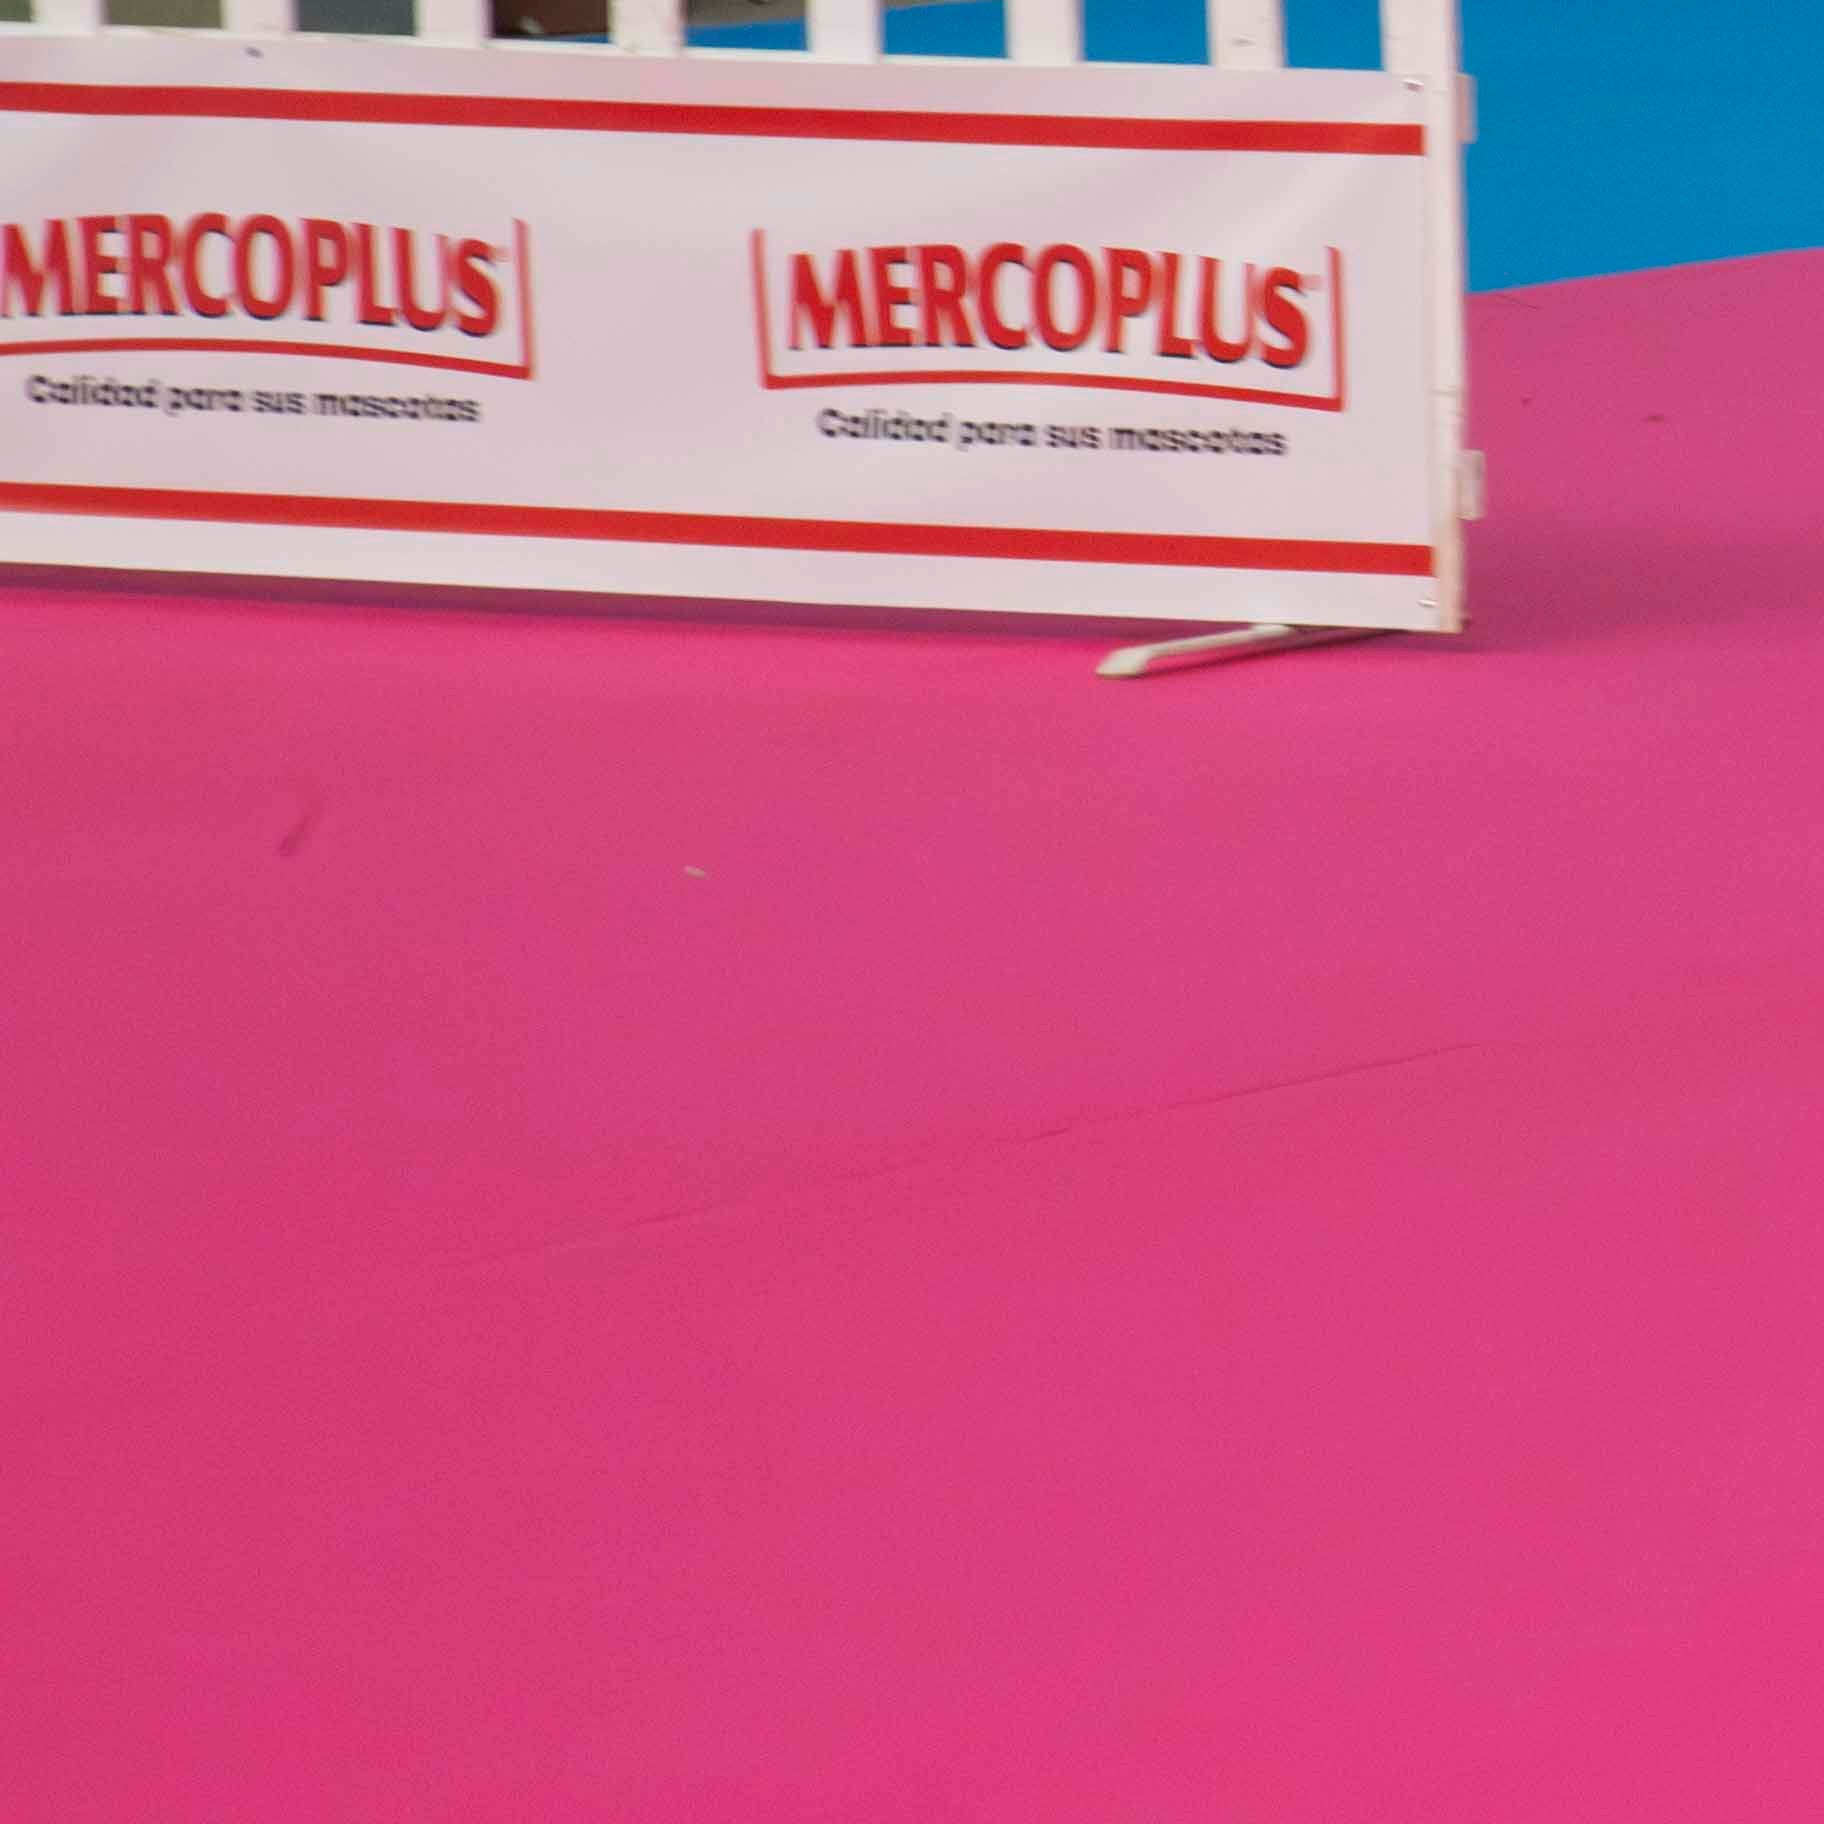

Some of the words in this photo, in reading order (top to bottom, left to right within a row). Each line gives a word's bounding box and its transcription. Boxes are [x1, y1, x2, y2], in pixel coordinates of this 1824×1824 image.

[0, 213, 498, 337] MERCOPLUS
[788, 242, 1308, 368] MERCOPLUS
[24, 374, 160, 410] Calidad
[165, 385, 243, 417] para
[251, 388, 306, 416] sus
[313, 390, 482, 423] mascotas
[815, 406, 950, 443] Calidad
[955, 418, 1039, 452] para
[1044, 422, 1103, 450] sus
[1109, 423, 1289, 457] mascotas
